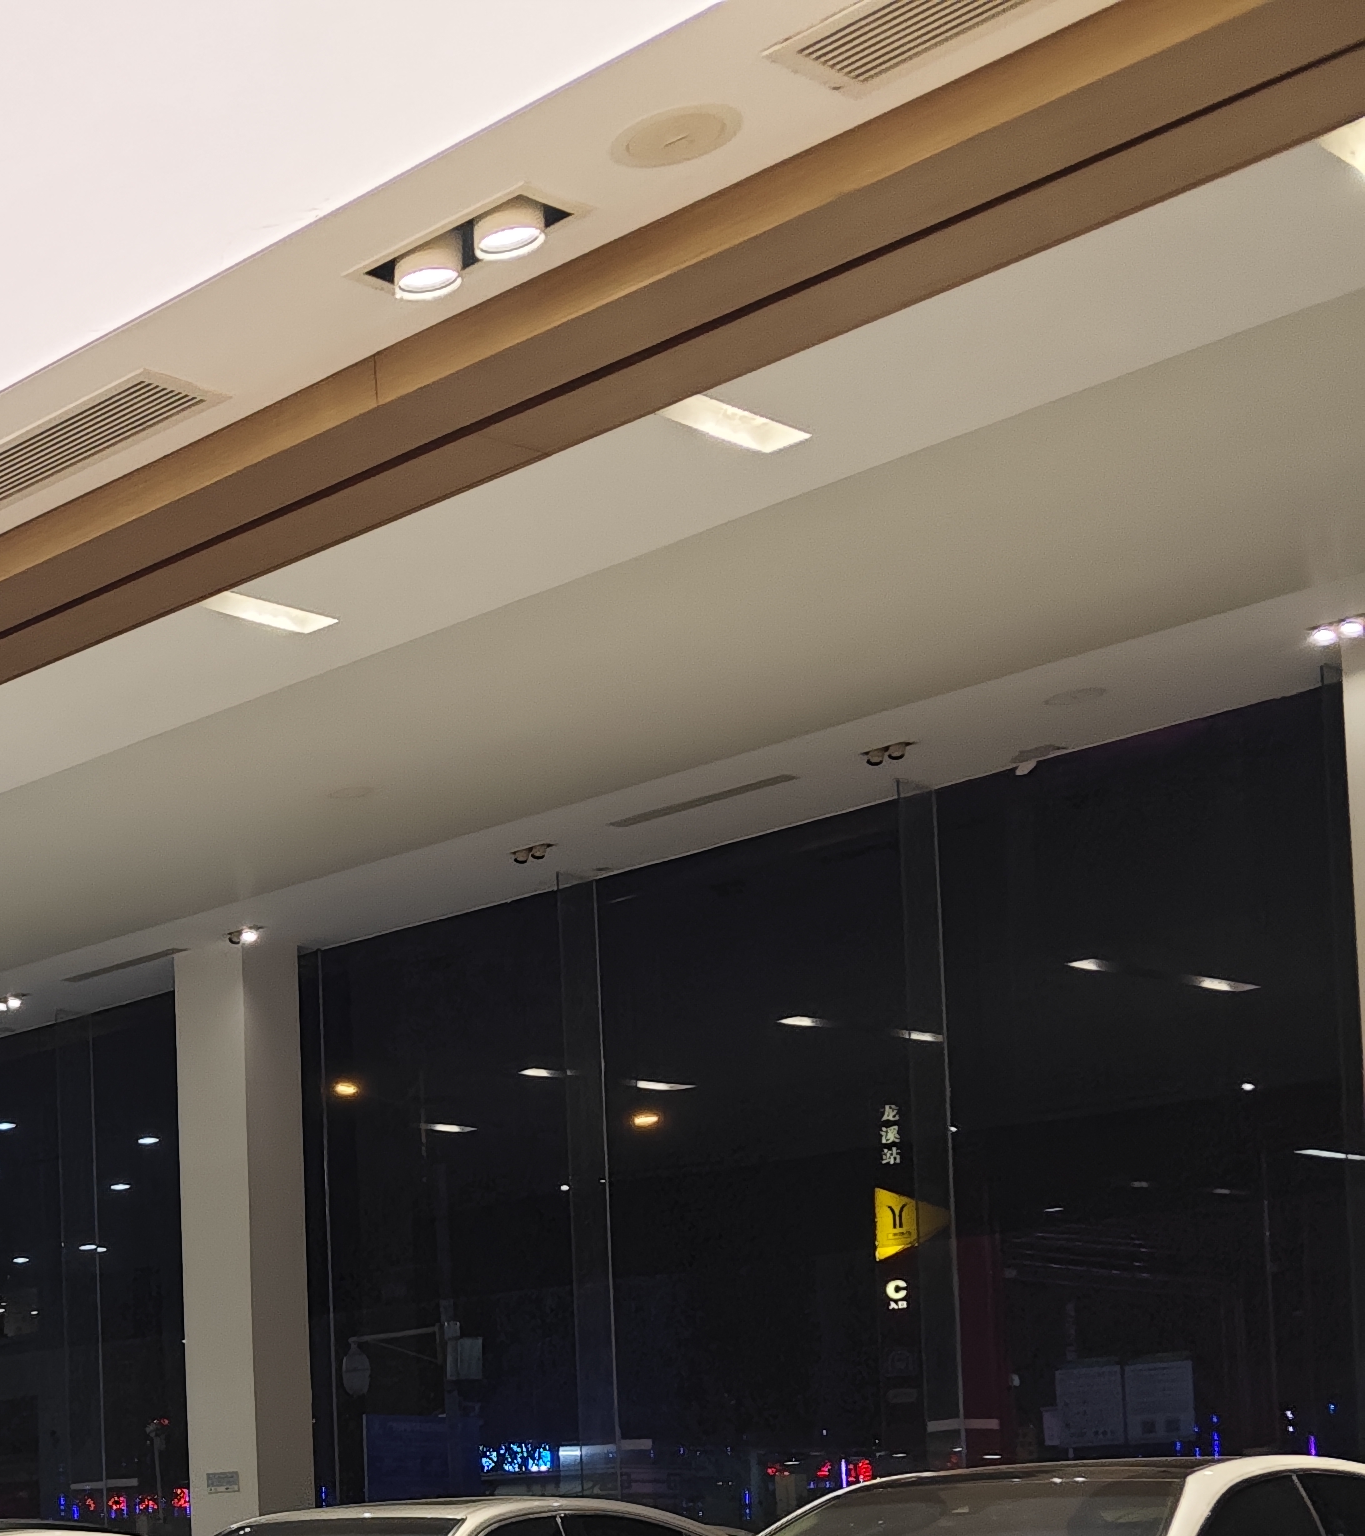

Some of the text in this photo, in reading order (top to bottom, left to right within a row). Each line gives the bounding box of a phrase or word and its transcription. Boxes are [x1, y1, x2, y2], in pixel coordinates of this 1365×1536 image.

[879, 1104, 901, 1165] 龙溪站
[885, 1279, 908, 1300] C
